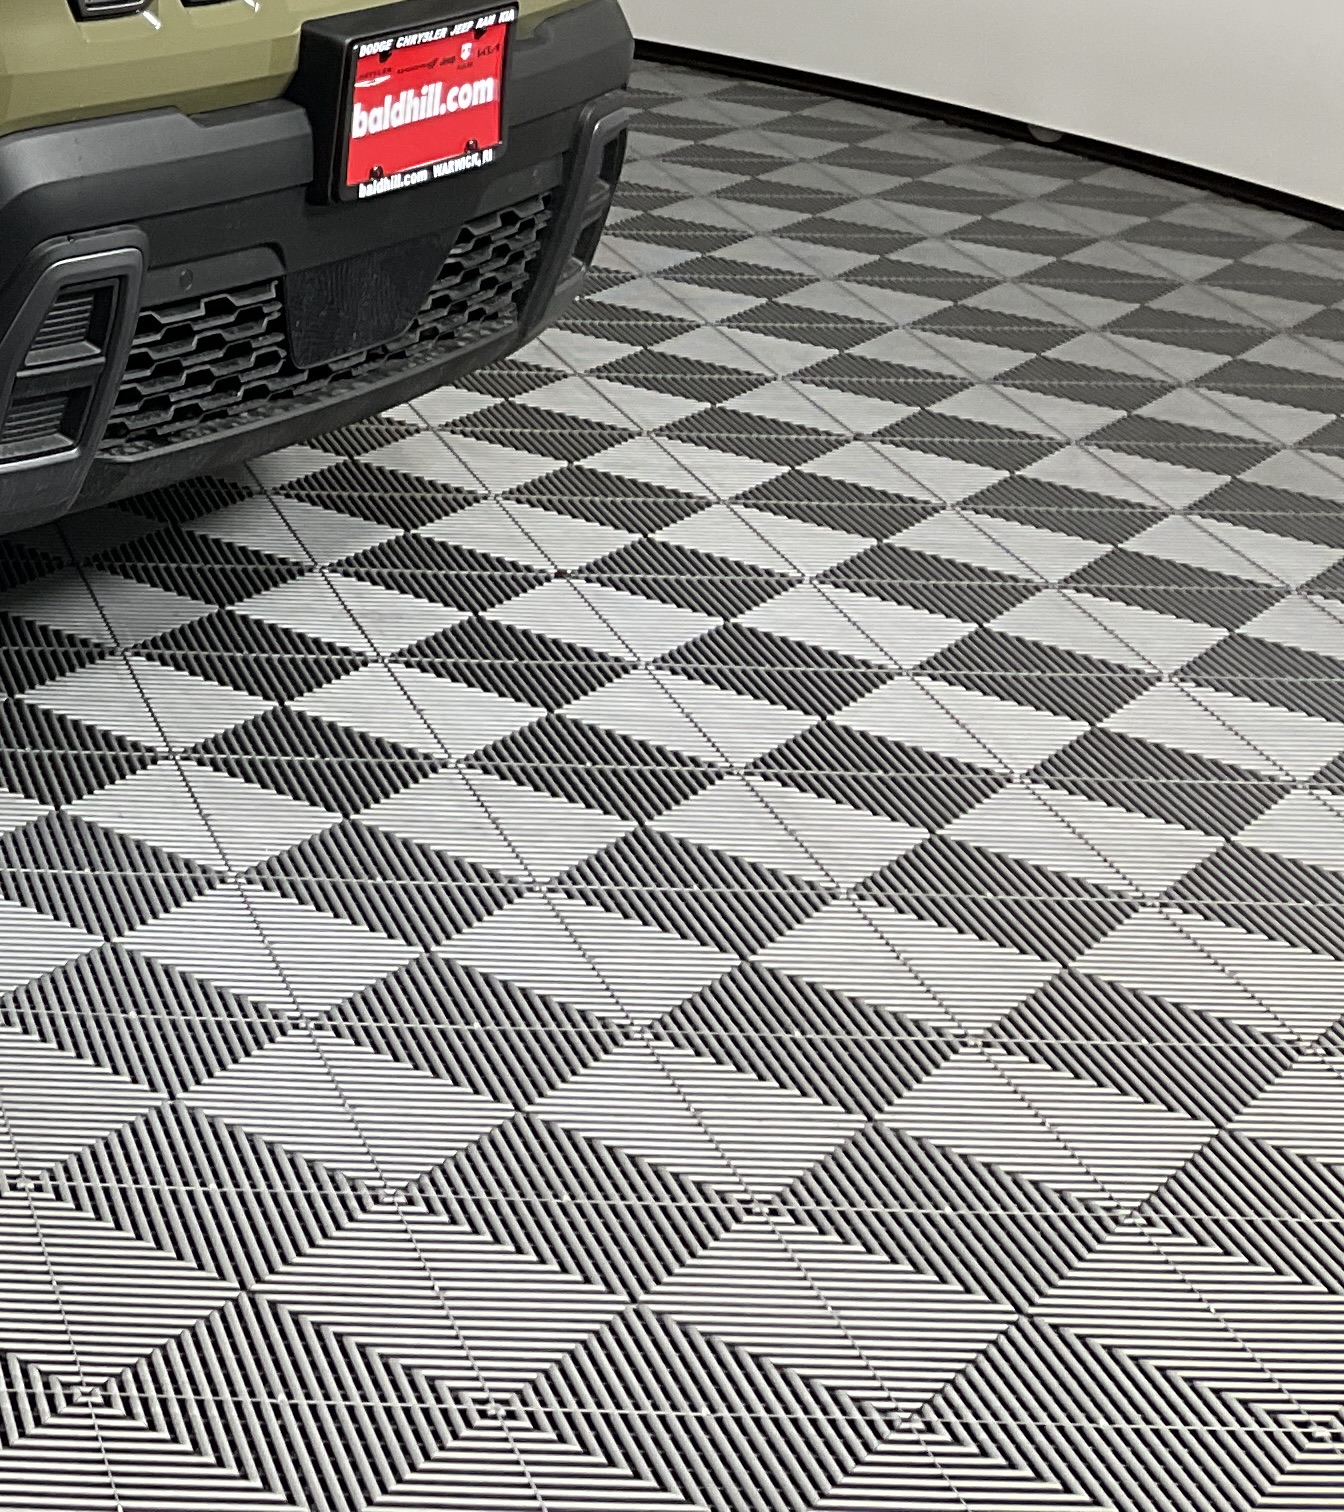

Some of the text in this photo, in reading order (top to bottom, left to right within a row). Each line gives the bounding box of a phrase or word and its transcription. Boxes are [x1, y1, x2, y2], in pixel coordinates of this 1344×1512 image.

[358, 8, 515, 58] DODGE CHRYSLER JEEP RAM KIA
[351, 77, 494, 139] baldhill.com
[358, 148, 493, 199] baldhill.com WARWICK, RI
